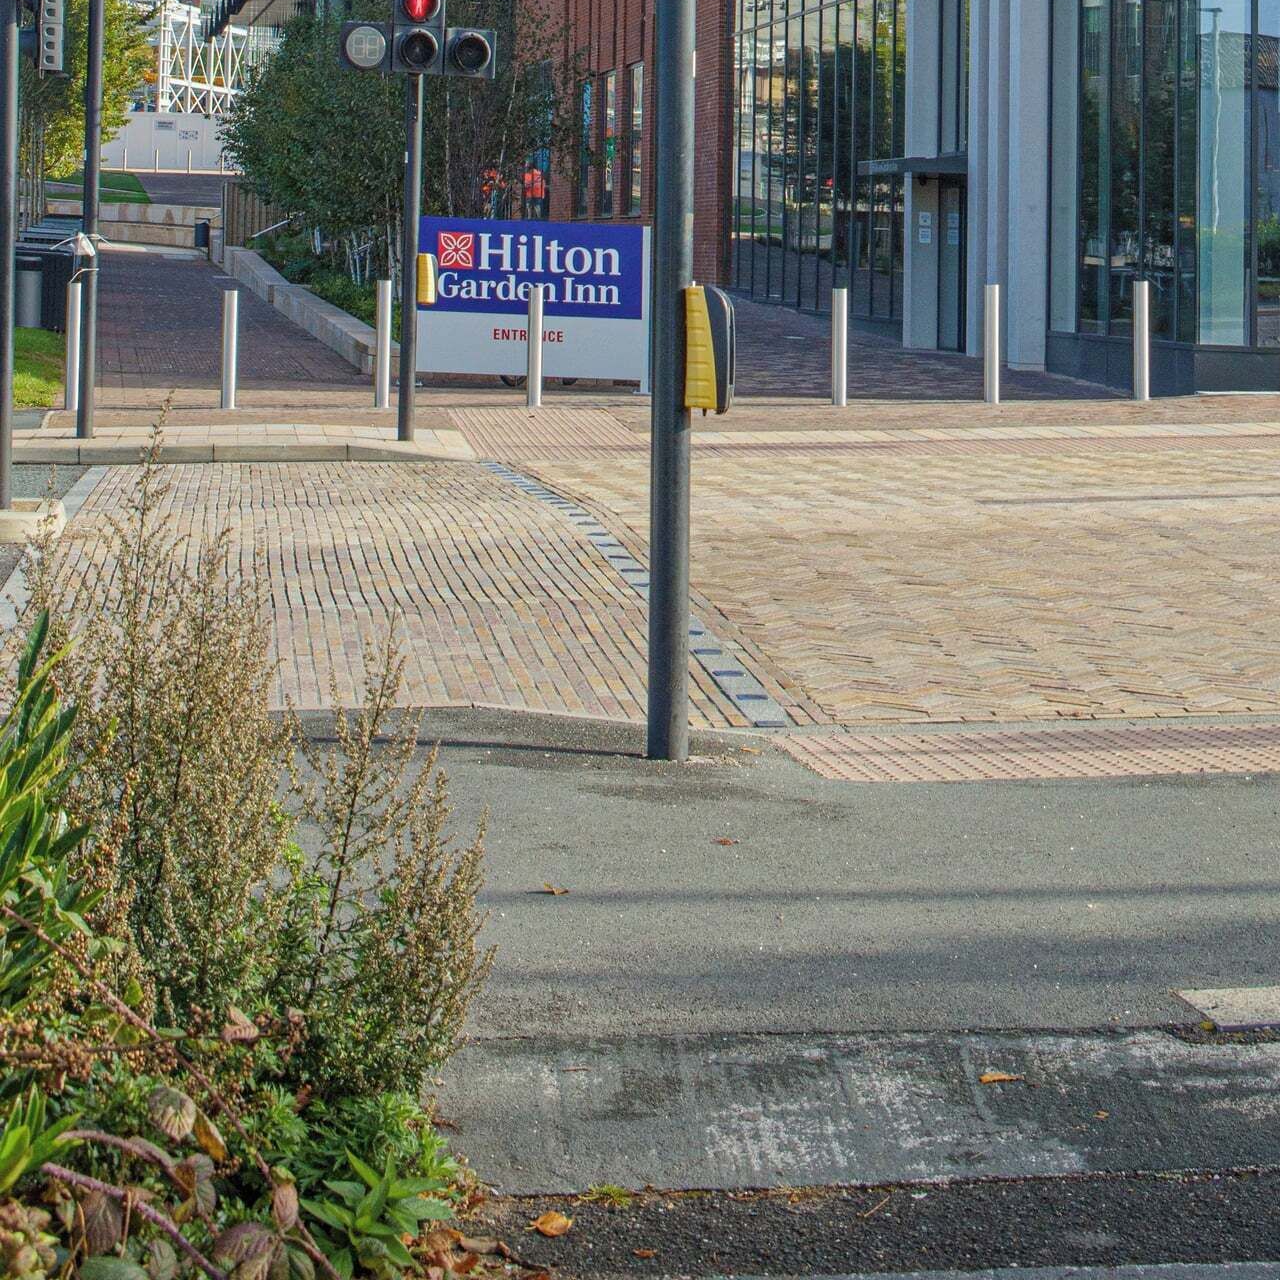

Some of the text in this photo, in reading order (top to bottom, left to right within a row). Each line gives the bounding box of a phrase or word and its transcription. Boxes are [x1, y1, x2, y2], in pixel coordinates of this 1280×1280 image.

[478, 232, 622, 276] Hilton
[437, 271, 622, 305] Garden Inn
[493, 328, 564, 343] ENTRCE
